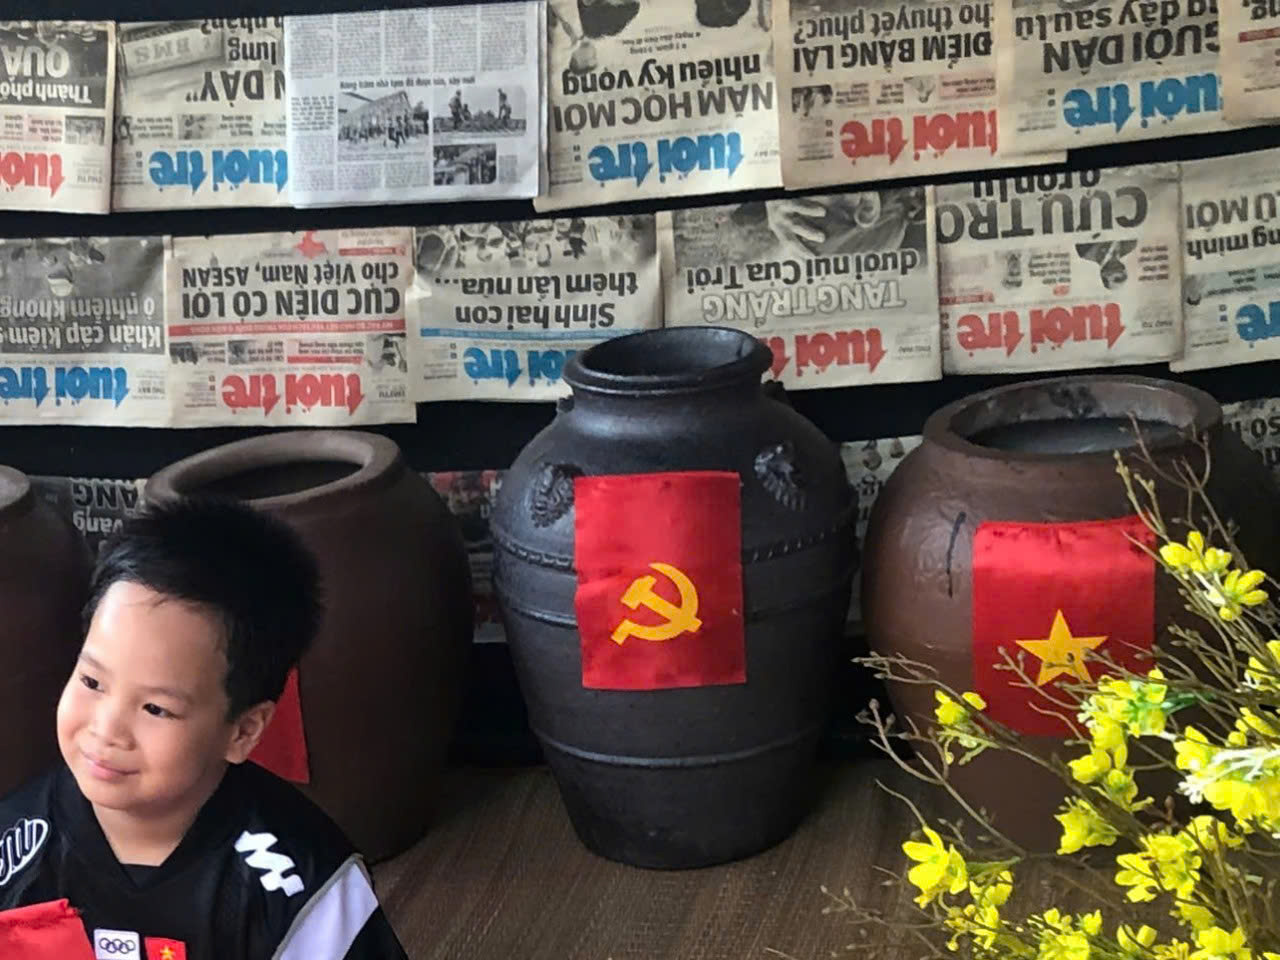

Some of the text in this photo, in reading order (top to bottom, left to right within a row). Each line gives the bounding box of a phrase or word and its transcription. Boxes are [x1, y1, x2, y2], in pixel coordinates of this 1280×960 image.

[870, 6, 953, 37] thuyết
[1054, 8, 1112, 34] sau
[1043, 34, 1124, 76] DÂN
[562, 67, 634, 95] vọng
[679, 54, 761, 88] nhiều
[0, 80, 34, 102] phố
[35, 84, 92, 104] Thành
[1140, 74, 1224, 128] uổi
[553, 82, 773, 136] NĂM HỌC MỚI
[149, 150, 288, 195] tuổi trẻ
[588, 132, 744, 188] tuổi trẻ
[1042, 186, 1148, 239] CỨU
[1186, 233, 1249, 260] minh
[183, 259, 399, 288] cho Việt Nam, ASEAN
[855, 250, 918, 280] dưới
[517, 276, 560, 302] lần
[566, 272, 638, 297] thêm
[0, 296, 65, 322] không
[456, 303, 615, 330] Sinh hai con
[8, 326, 60, 351] kiểm
[956, 303, 1125, 357] tuổi trẻ
[795, 328, 886, 377] tuổi
[527, 350, 580, 387] ổi
[55, 367, 130, 409] tuổi
[222, 373, 365, 416] tuổi trẻ
